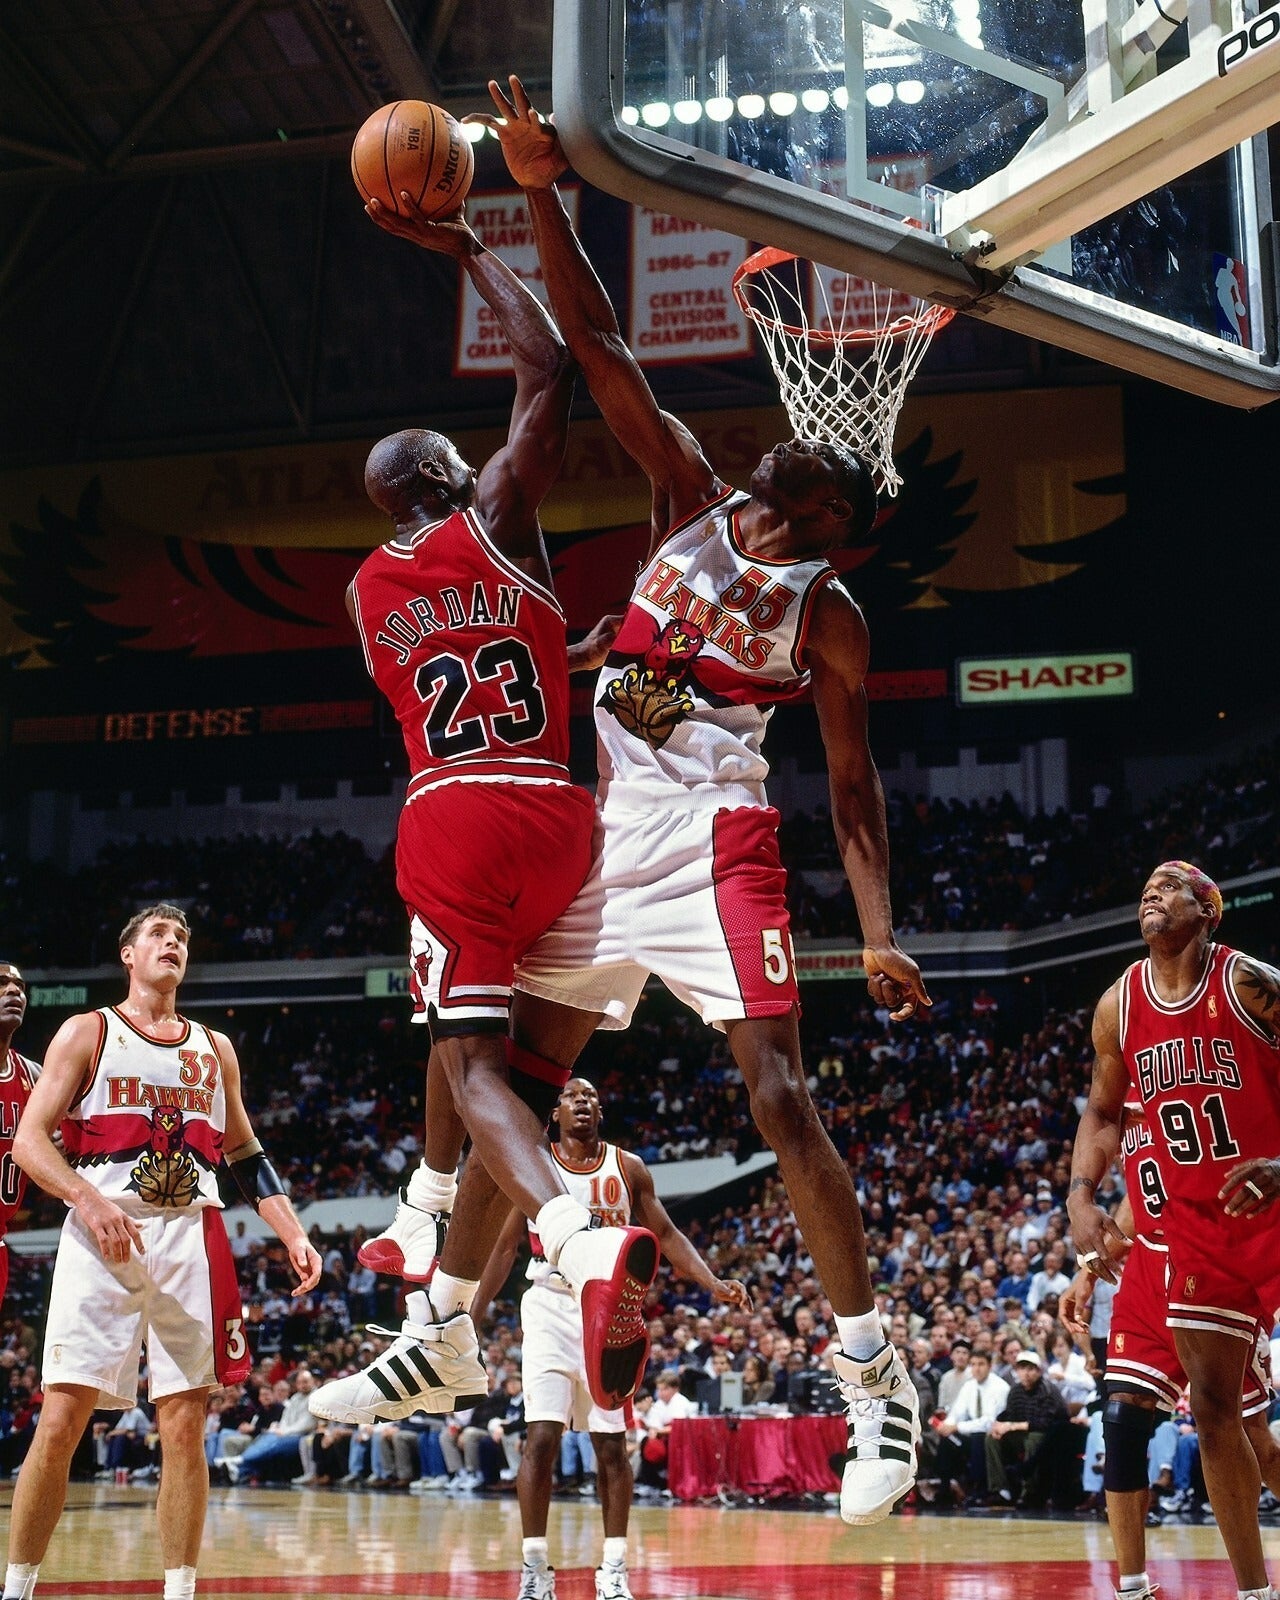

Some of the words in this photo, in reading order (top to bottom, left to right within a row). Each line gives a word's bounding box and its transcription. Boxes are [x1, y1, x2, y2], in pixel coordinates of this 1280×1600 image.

[407, 127, 421, 151] NBA
[473, 207, 528, 228] ATLA
[650, 289, 726, 309] CENTRAL
[651, 307, 727, 328] DIVISION
[638, 324, 741, 347] CHAMPIONS
[1220, 329, 1239, 345] NBA
[637, 558, 776, 670] HAWKS
[719, 565, 798, 633] 55
[375, 580, 524, 666] JORDAN
[966, 662, 1128, 693] SHARP
[413, 635, 548, 761] 23
[103, 706, 253, 743] DEFENSE
[178, 1048, 219, 1094] 32
[1133, 1036, 1243, 1105] BULLS
[1156, 1092, 1241, 1166] 91
[589, 1174, 622, 1208] 10
[1137, 1156, 1169, 1219] 9
[225, 1317, 247, 1361] 3
